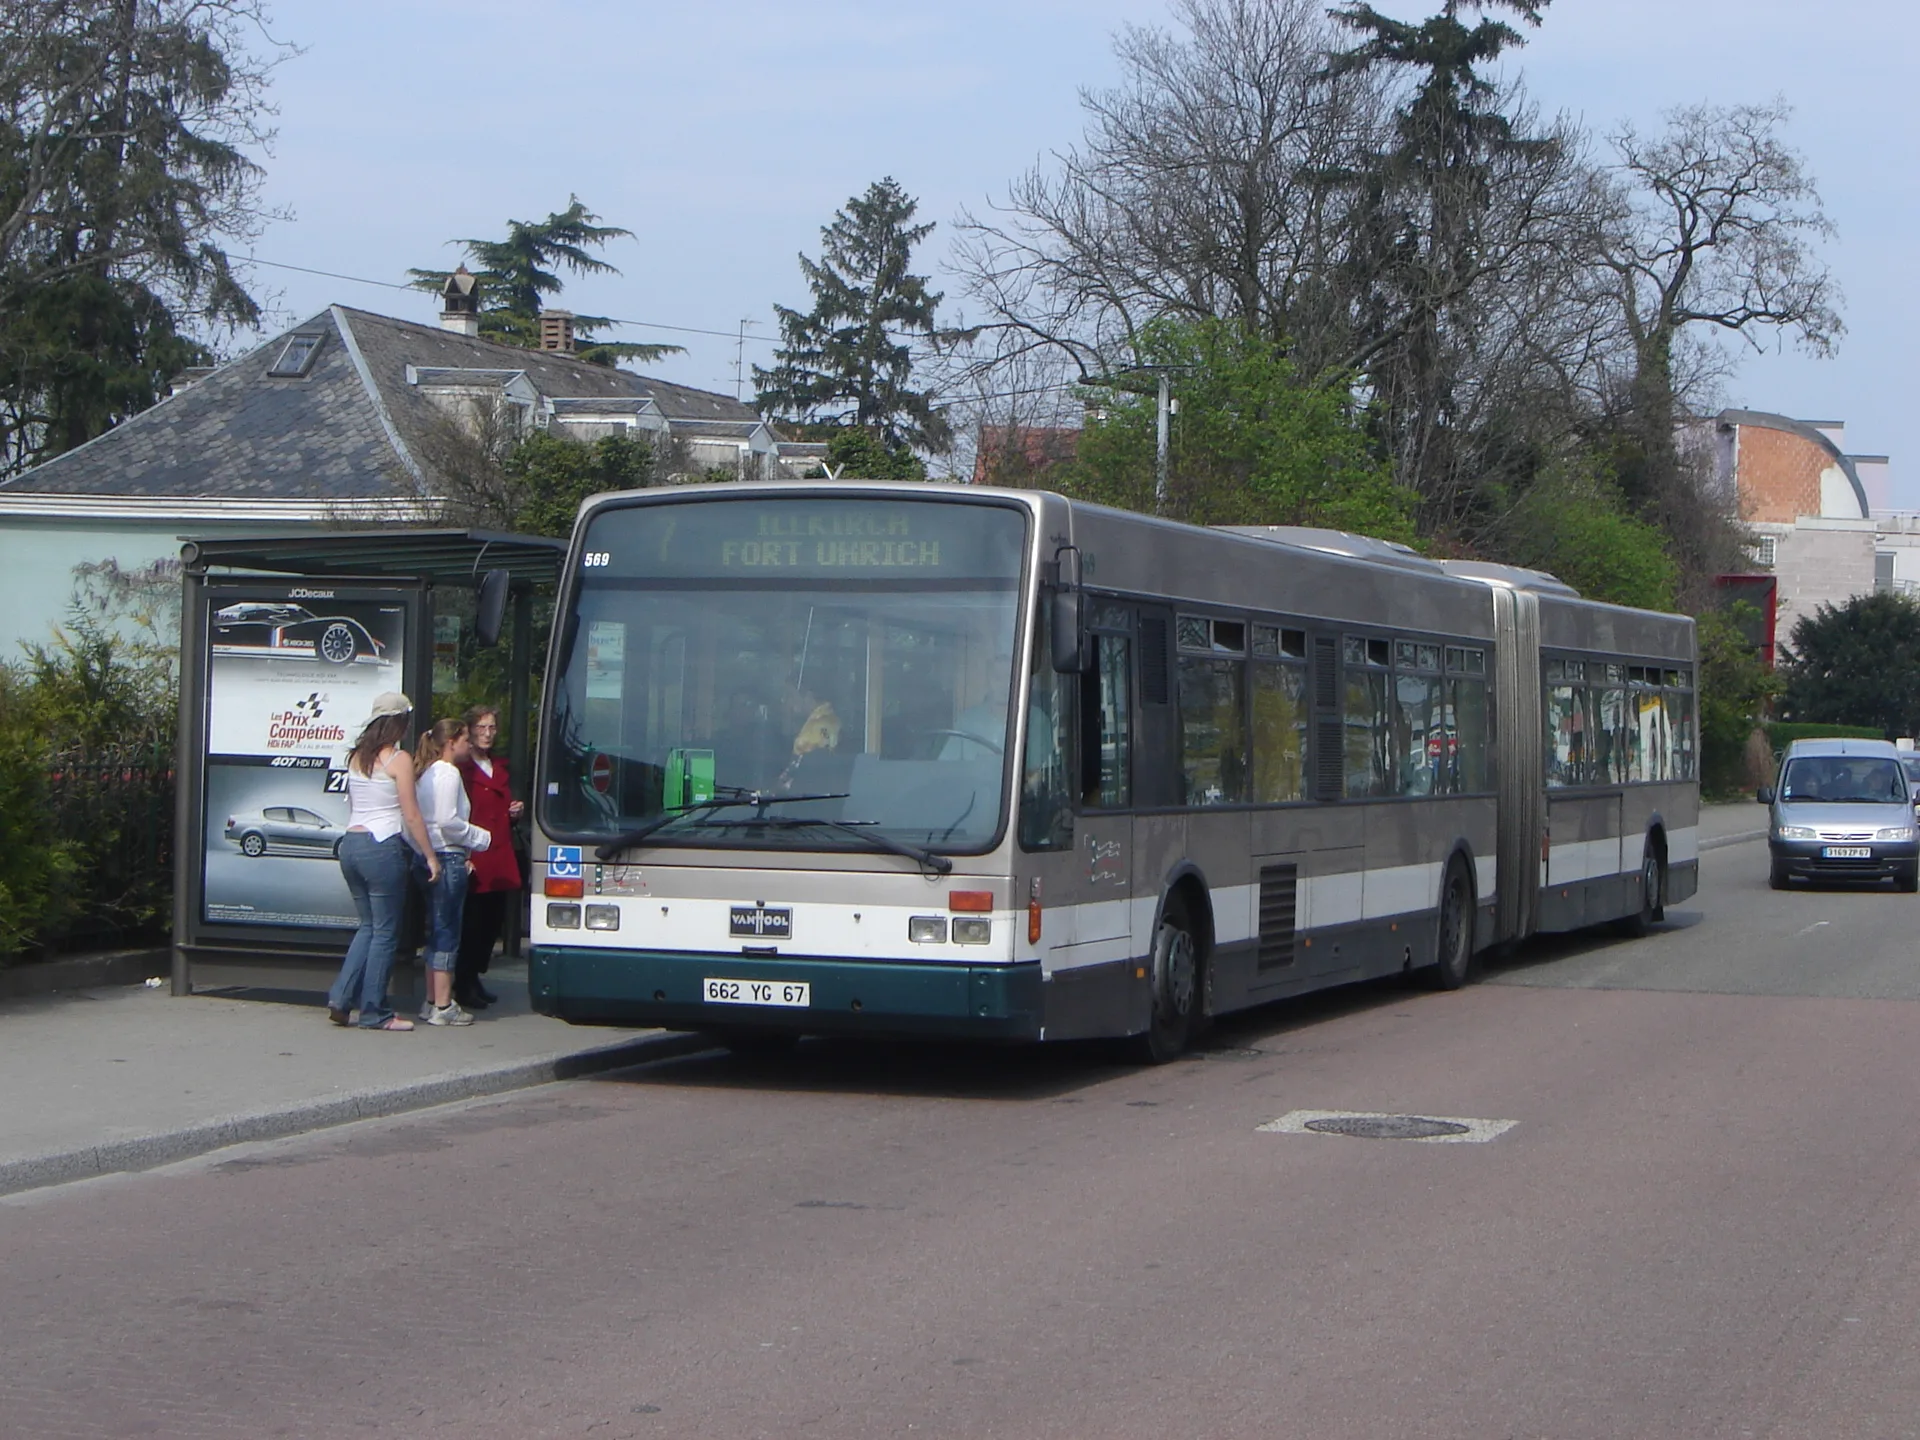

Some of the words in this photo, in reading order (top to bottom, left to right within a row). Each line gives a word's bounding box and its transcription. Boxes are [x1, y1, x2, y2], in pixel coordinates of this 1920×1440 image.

[584, 552, 610, 567] 569
[722, 541, 802, 566] FORT
[816, 541, 940, 566] UHRICH
[288, 588, 335, 599] JCDecaux
[270, 711, 283, 721] Les
[282, 711, 310, 727] Prix
[269, 723, 345, 743] Compétitifs
[281, 740, 295, 749] FAP
[271, 756, 297, 768] 407
[311, 759, 325, 768] FAP
[709, 982, 740, 1000] 662
[751, 984, 772, 1001] YG
[783, 986, 804, 1003] 67
